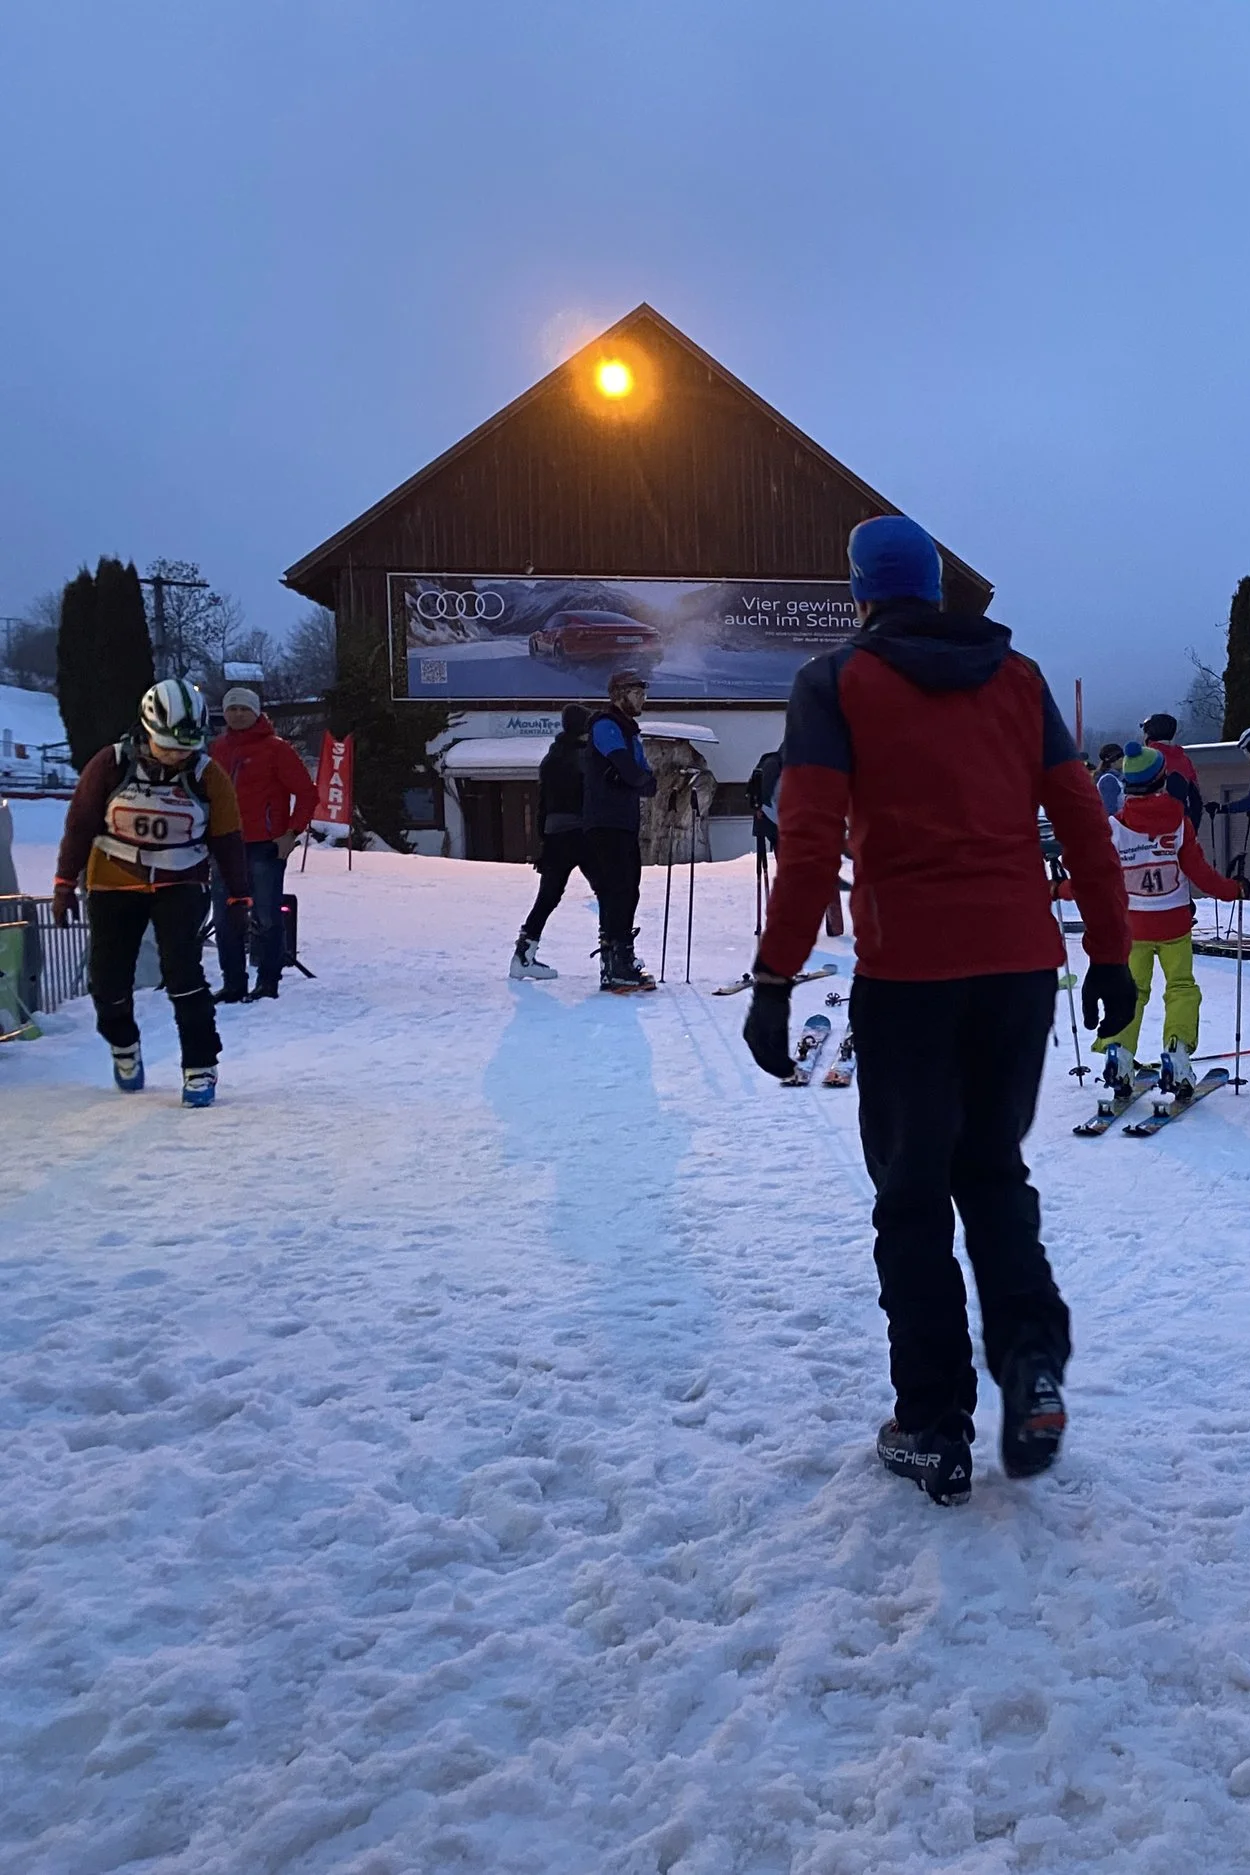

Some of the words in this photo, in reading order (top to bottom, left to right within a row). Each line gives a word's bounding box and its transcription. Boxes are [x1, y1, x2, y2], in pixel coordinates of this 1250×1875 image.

[741, 596, 780, 610] Vier
[786, 599, 855, 615] gewinn
[724, 612, 769, 626] auch
[776, 613, 800, 627] im
[806, 613, 862, 628] Schne
[327, 742, 346, 819] START
[134, 815, 168, 840] 60
[1141, 868, 1164, 893] 41
